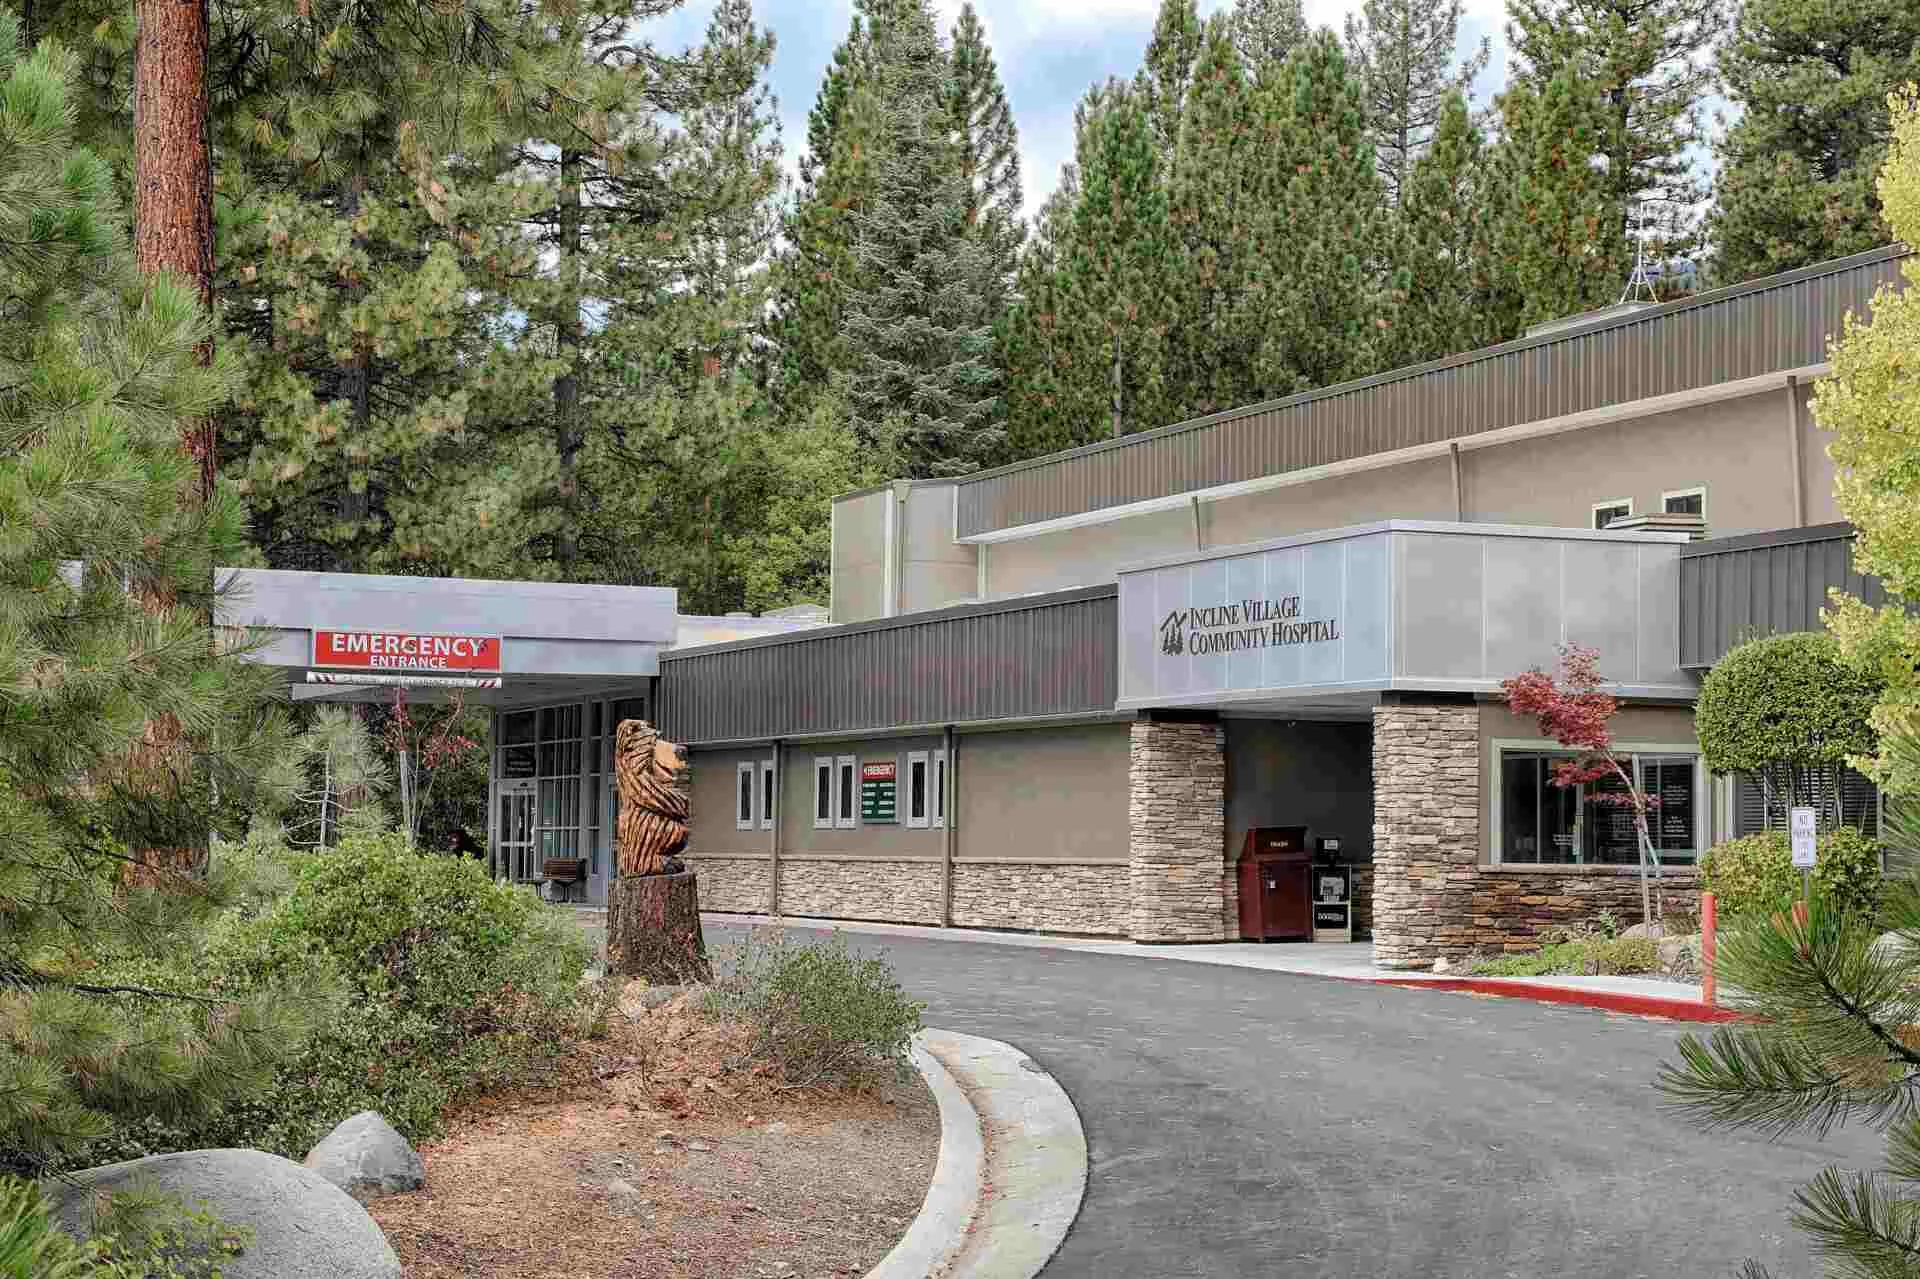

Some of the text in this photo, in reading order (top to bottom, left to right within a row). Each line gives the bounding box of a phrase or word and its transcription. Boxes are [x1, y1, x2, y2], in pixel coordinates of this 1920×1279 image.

[1190, 597, 1300, 628] INCLINE VILLAGE
[332, 634, 482, 656] EMERGENCY
[1190, 619, 1340, 655] COMMUNITY HOSPITAL
[370, 656, 447, 668] ENTRANCE
